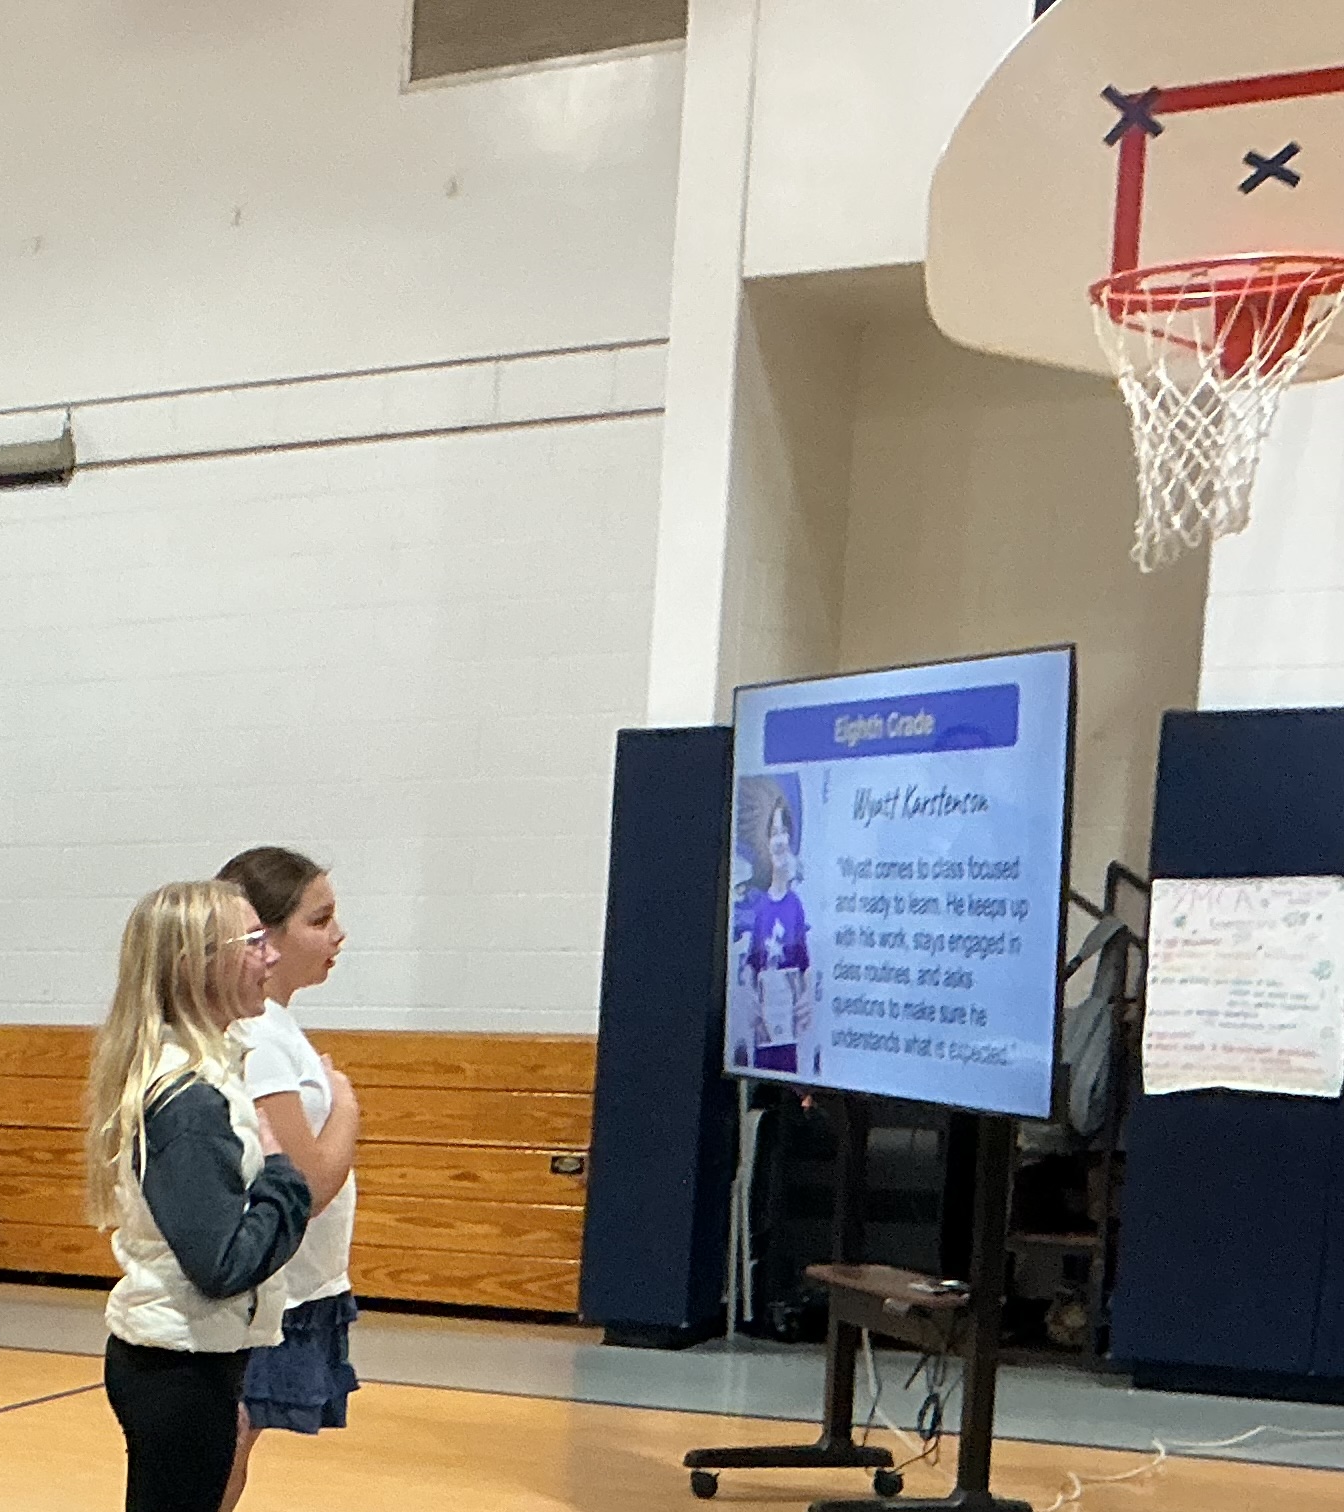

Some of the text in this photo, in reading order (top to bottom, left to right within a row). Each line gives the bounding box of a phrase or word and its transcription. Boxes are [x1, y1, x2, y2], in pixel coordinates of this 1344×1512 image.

[887, 708, 937, 738] Grade
[875, 861, 914, 880] comes
[916, 856, 929, 880] to
[931, 856, 964, 880] class
[967, 854, 1021, 881] focused
[835, 893, 857, 914] and
[859, 895, 890, 920] ready
[893, 893, 905, 915] to
[946, 892, 965, 917] He
[967, 893, 1008, 920] keeps
[1011, 898, 1030, 923] up
[835, 927, 857, 947] with
[859, 926, 876, 948] his
[912, 931, 946, 957] stays
[948, 932, 1005, 960] engaged
[1008, 934, 1023, 953] in
[833, 957, 862, 982] class
[916, 963, 940, 987] and
[942, 966, 974, 990] asks
[831, 994, 988, 1027] questions to make sure he
[831, 1028, 900, 1055] understands
[903, 1035, 932, 1057] what
[934, 1041, 947, 1060] is
